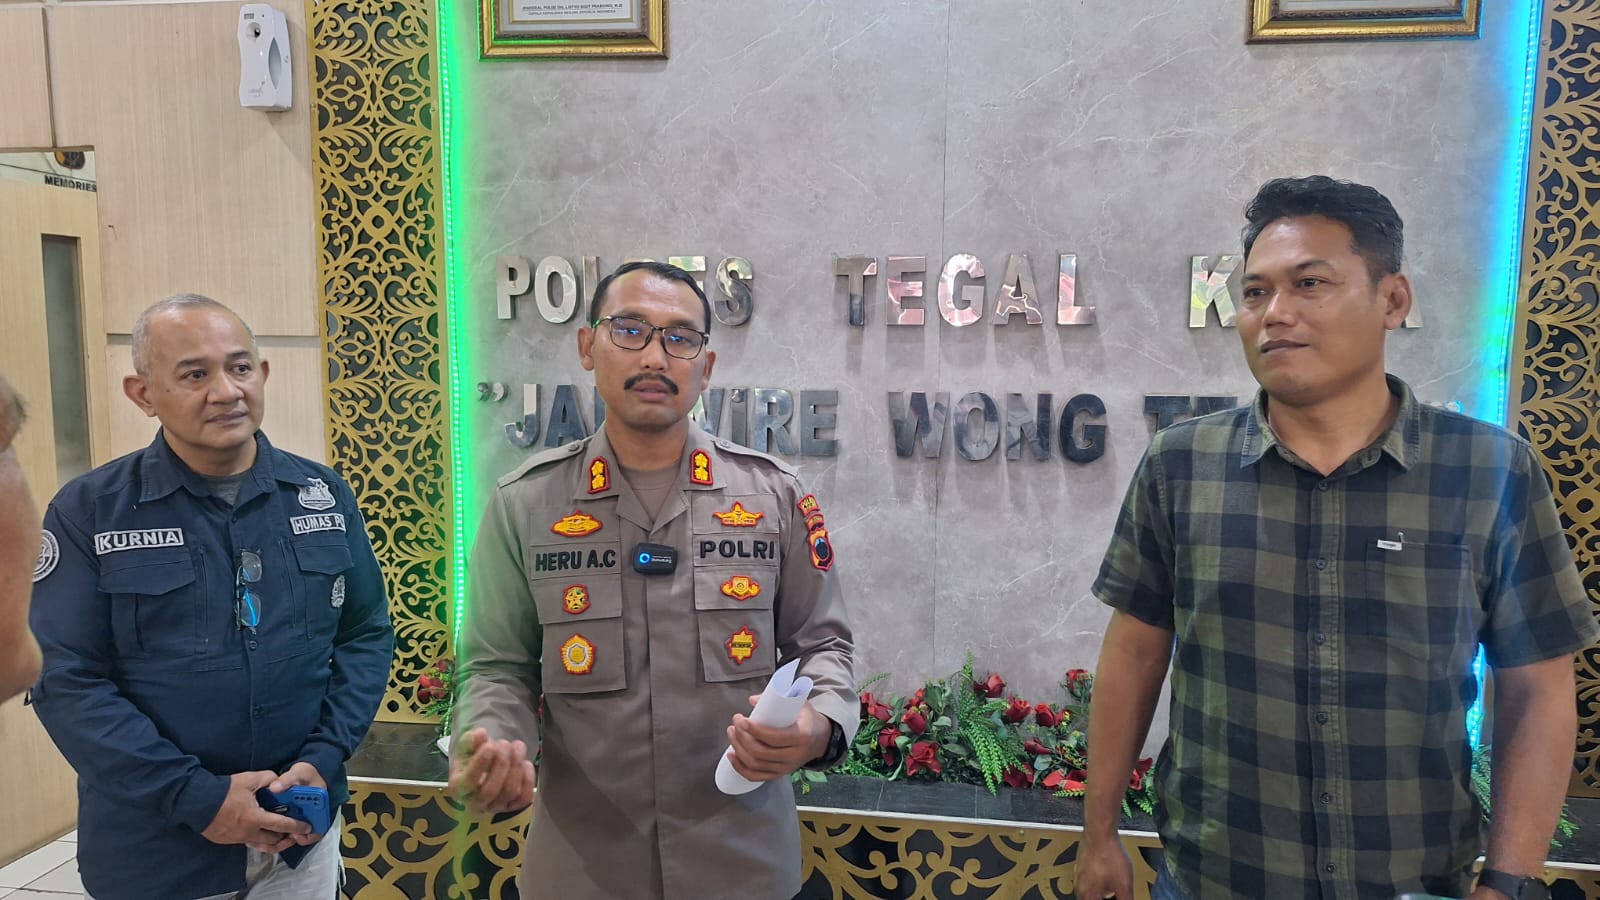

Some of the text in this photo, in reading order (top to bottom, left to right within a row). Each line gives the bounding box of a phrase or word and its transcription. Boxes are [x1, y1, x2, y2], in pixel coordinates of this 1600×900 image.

[44, 175, 97, 192] MEMORIES
[496, 254, 1096, 328] POLS TEGAL
[888, 391, 1107, 463] WONG
[294, 516, 332, 532] HUMAS
[99, 531, 179, 551] KURNIA
[700, 539, 775, 560] POLRI
[535, 549, 616, 571] HERU A.C
